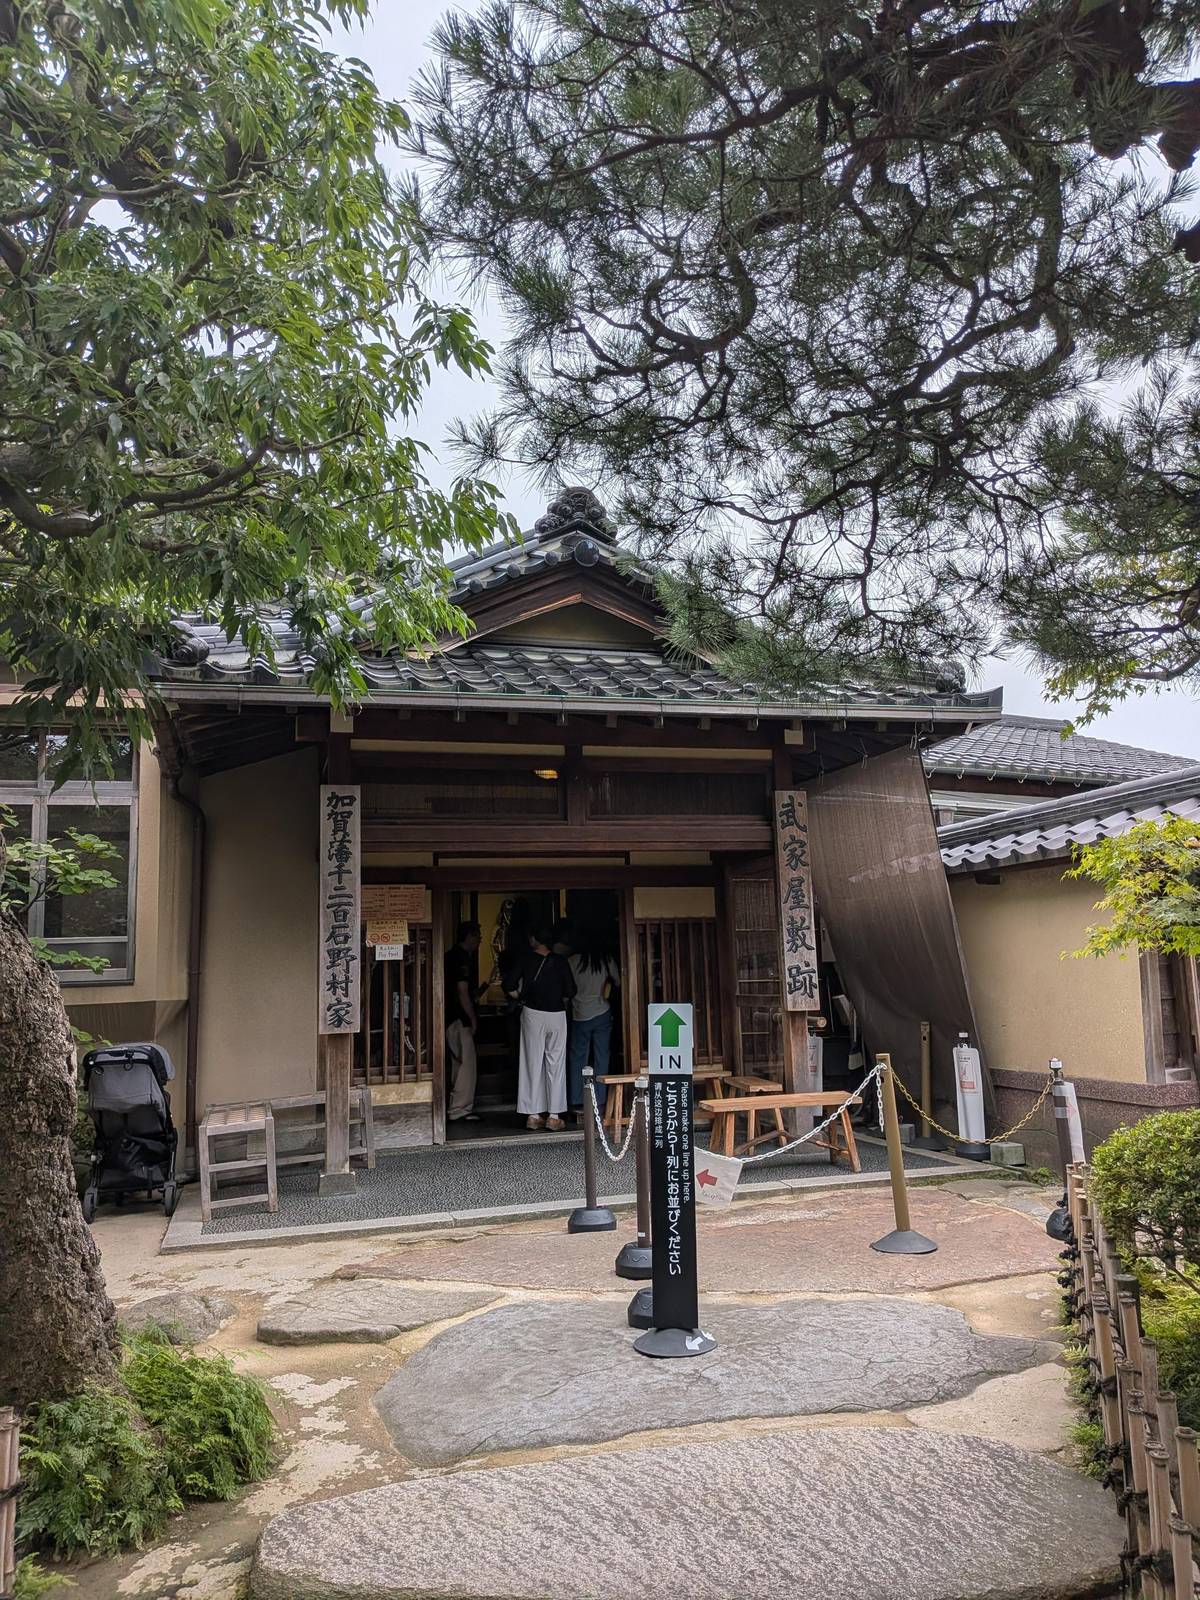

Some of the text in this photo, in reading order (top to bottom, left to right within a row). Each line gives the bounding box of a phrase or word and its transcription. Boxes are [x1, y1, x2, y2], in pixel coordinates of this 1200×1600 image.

[777, 794, 818, 999] 武家屋敷跡
[325, 791, 358, 1028] 加賀藩千二百石野村家
[659, 1054, 681, 1069] IN
[681, 1081, 689, 1108] Please
[681, 1109, 689, 1132] make
[682, 1152, 690, 1167] line
[681, 1170, 689, 1180] up
[683, 1182, 691, 1204] here.
